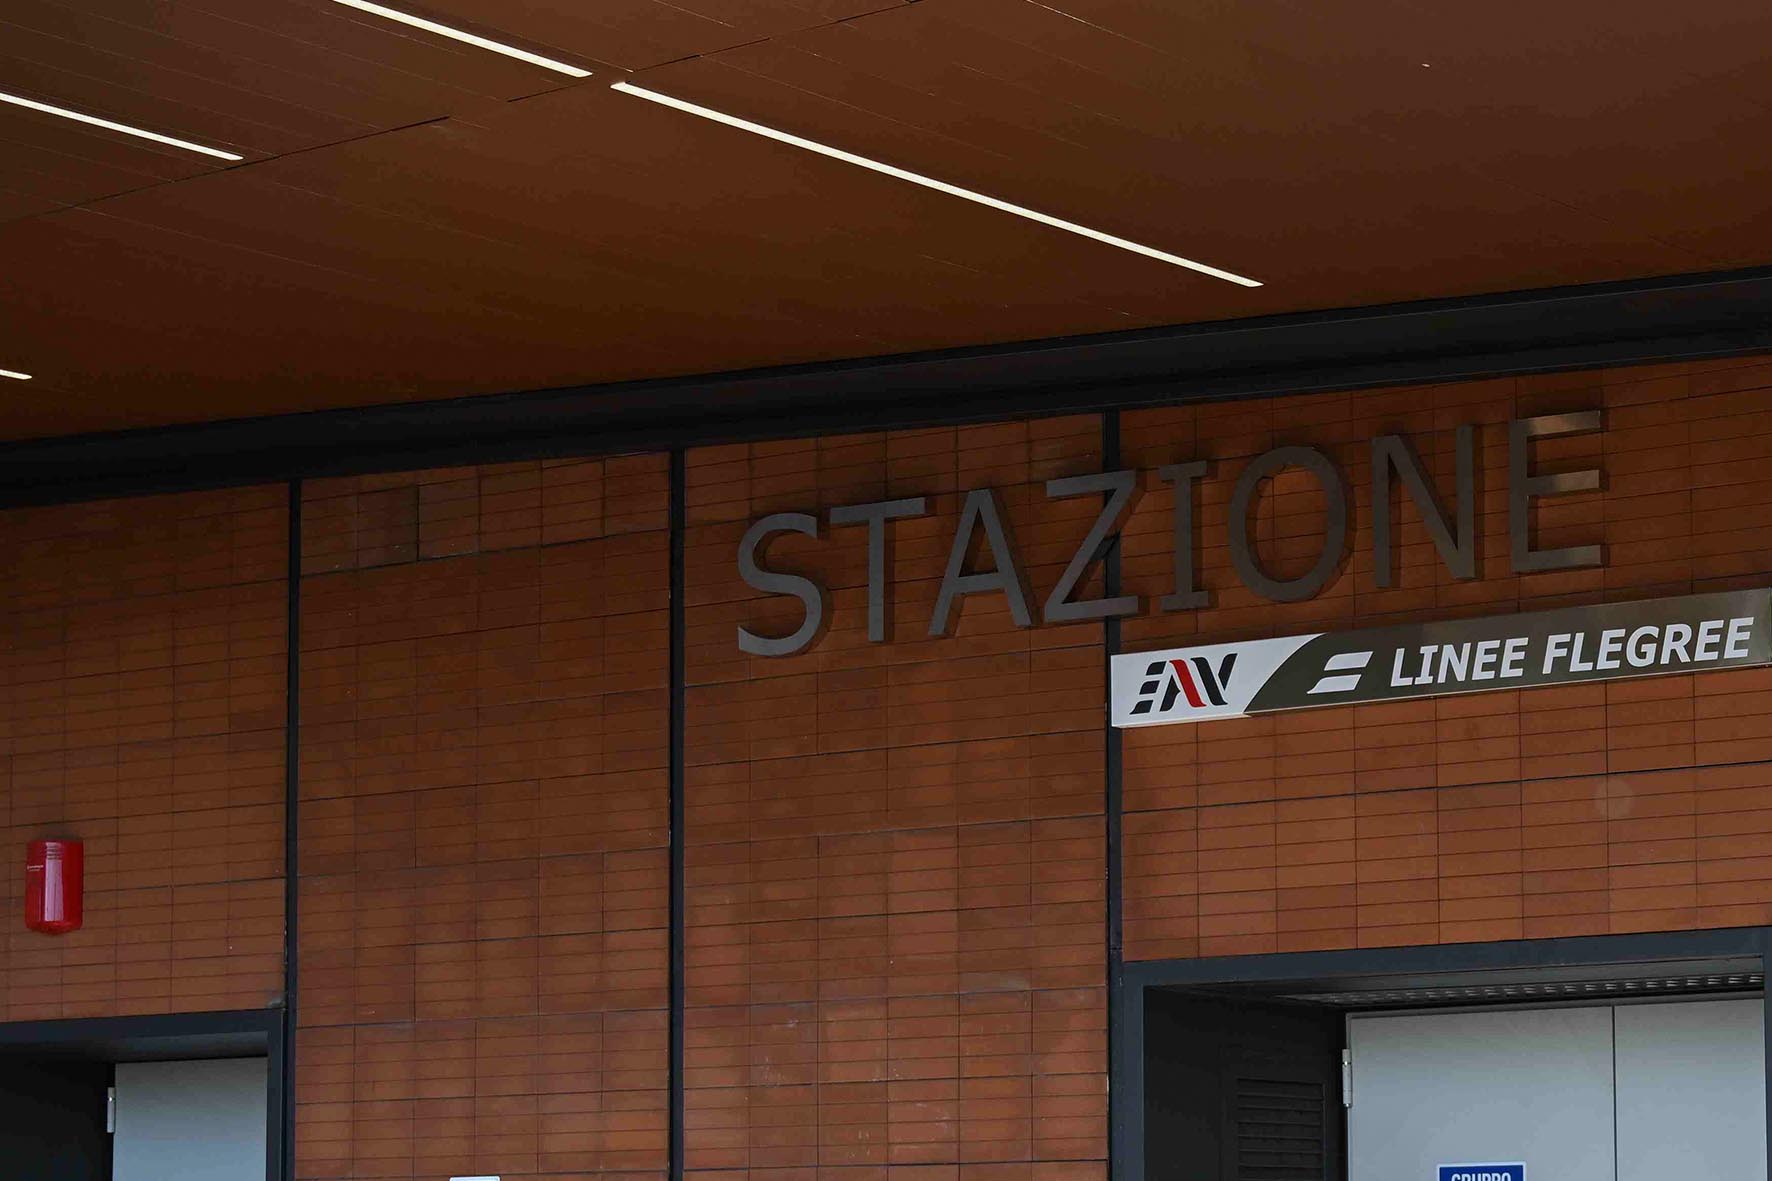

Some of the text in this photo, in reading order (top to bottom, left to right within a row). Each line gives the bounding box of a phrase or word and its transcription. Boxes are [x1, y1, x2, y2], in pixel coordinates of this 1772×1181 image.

[736, 409, 1602, 658] STAZIONE
[1390, 616, 1755, 688] LINEE FLEGREE
